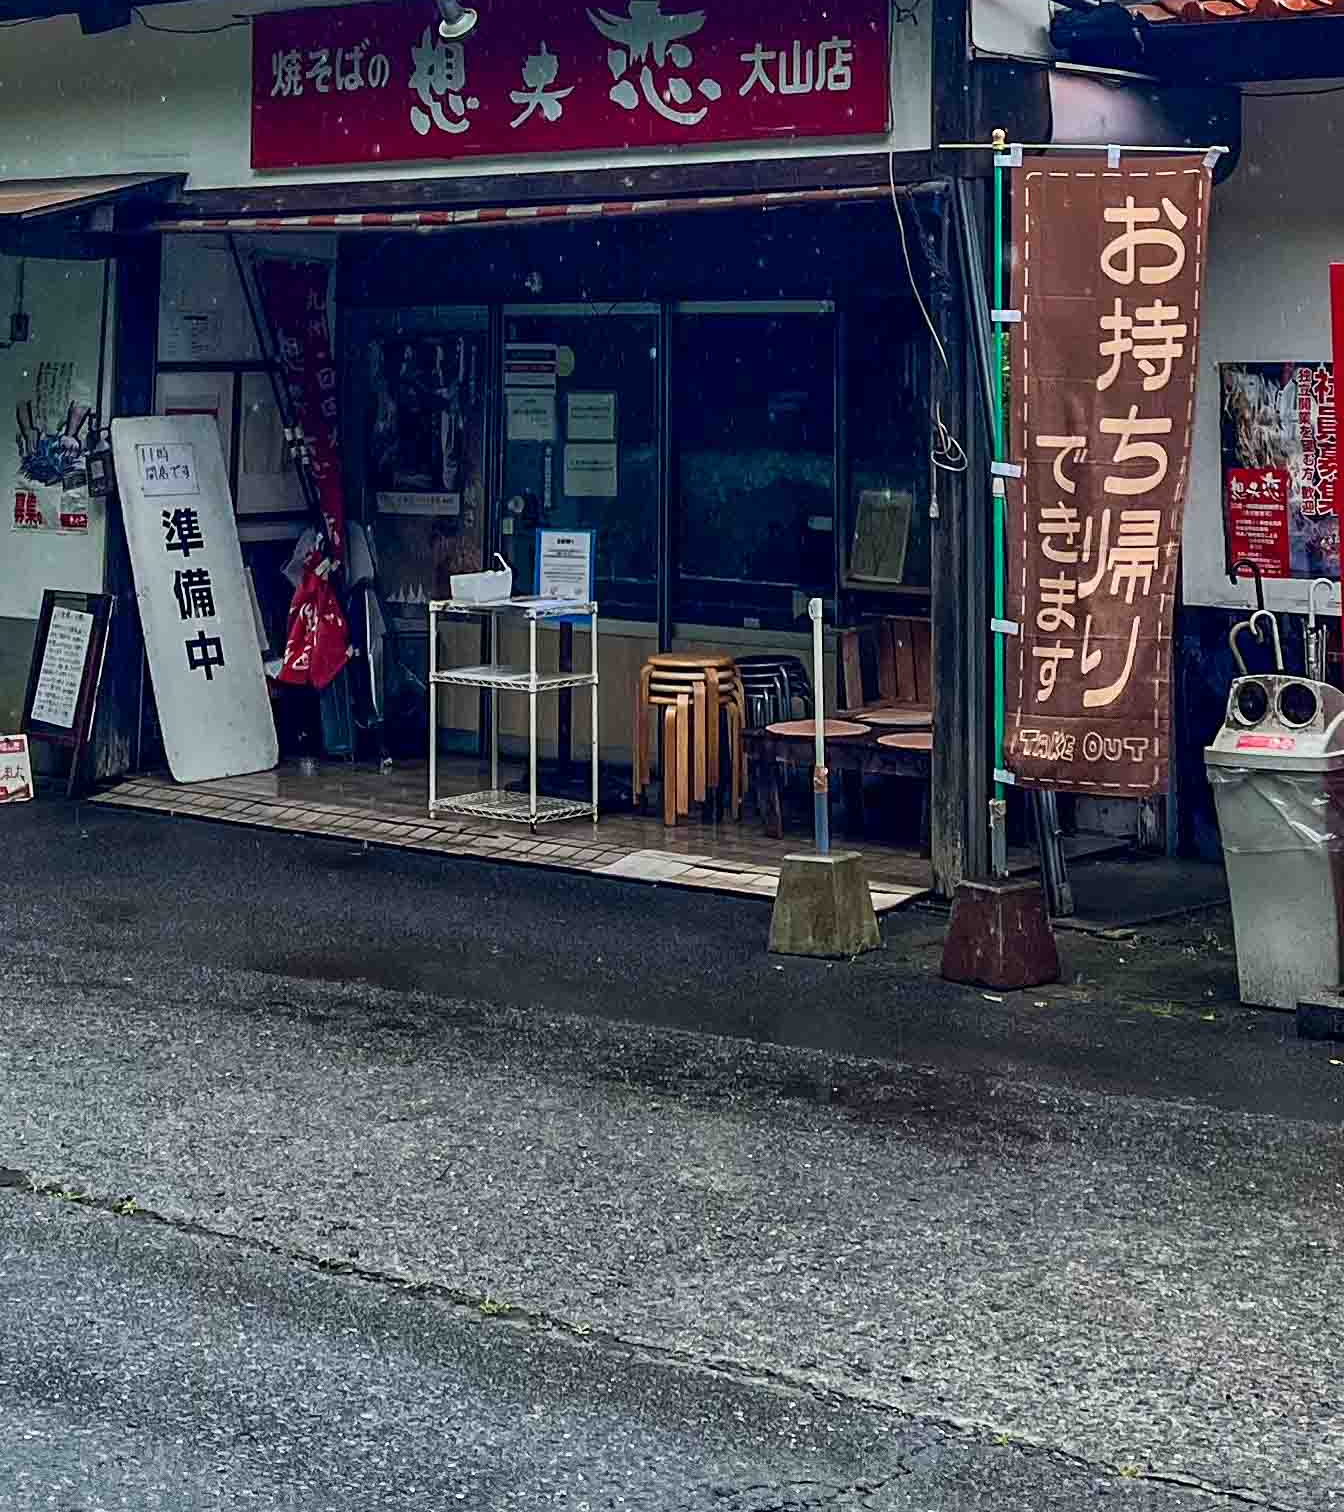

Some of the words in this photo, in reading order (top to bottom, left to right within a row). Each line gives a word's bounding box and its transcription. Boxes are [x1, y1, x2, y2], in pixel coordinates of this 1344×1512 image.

[271, 39, 390, 97] 焼そばの
[739, 38, 853, 96] 大山店
[1077, 196, 1188, 708] お持ち帰り
[160, 507, 226, 682] 準備中
[1032, 434, 1087, 703] できます
[1019, 728, 1076, 762] TAKE
[1083, 731, 1149, 762] OUT
